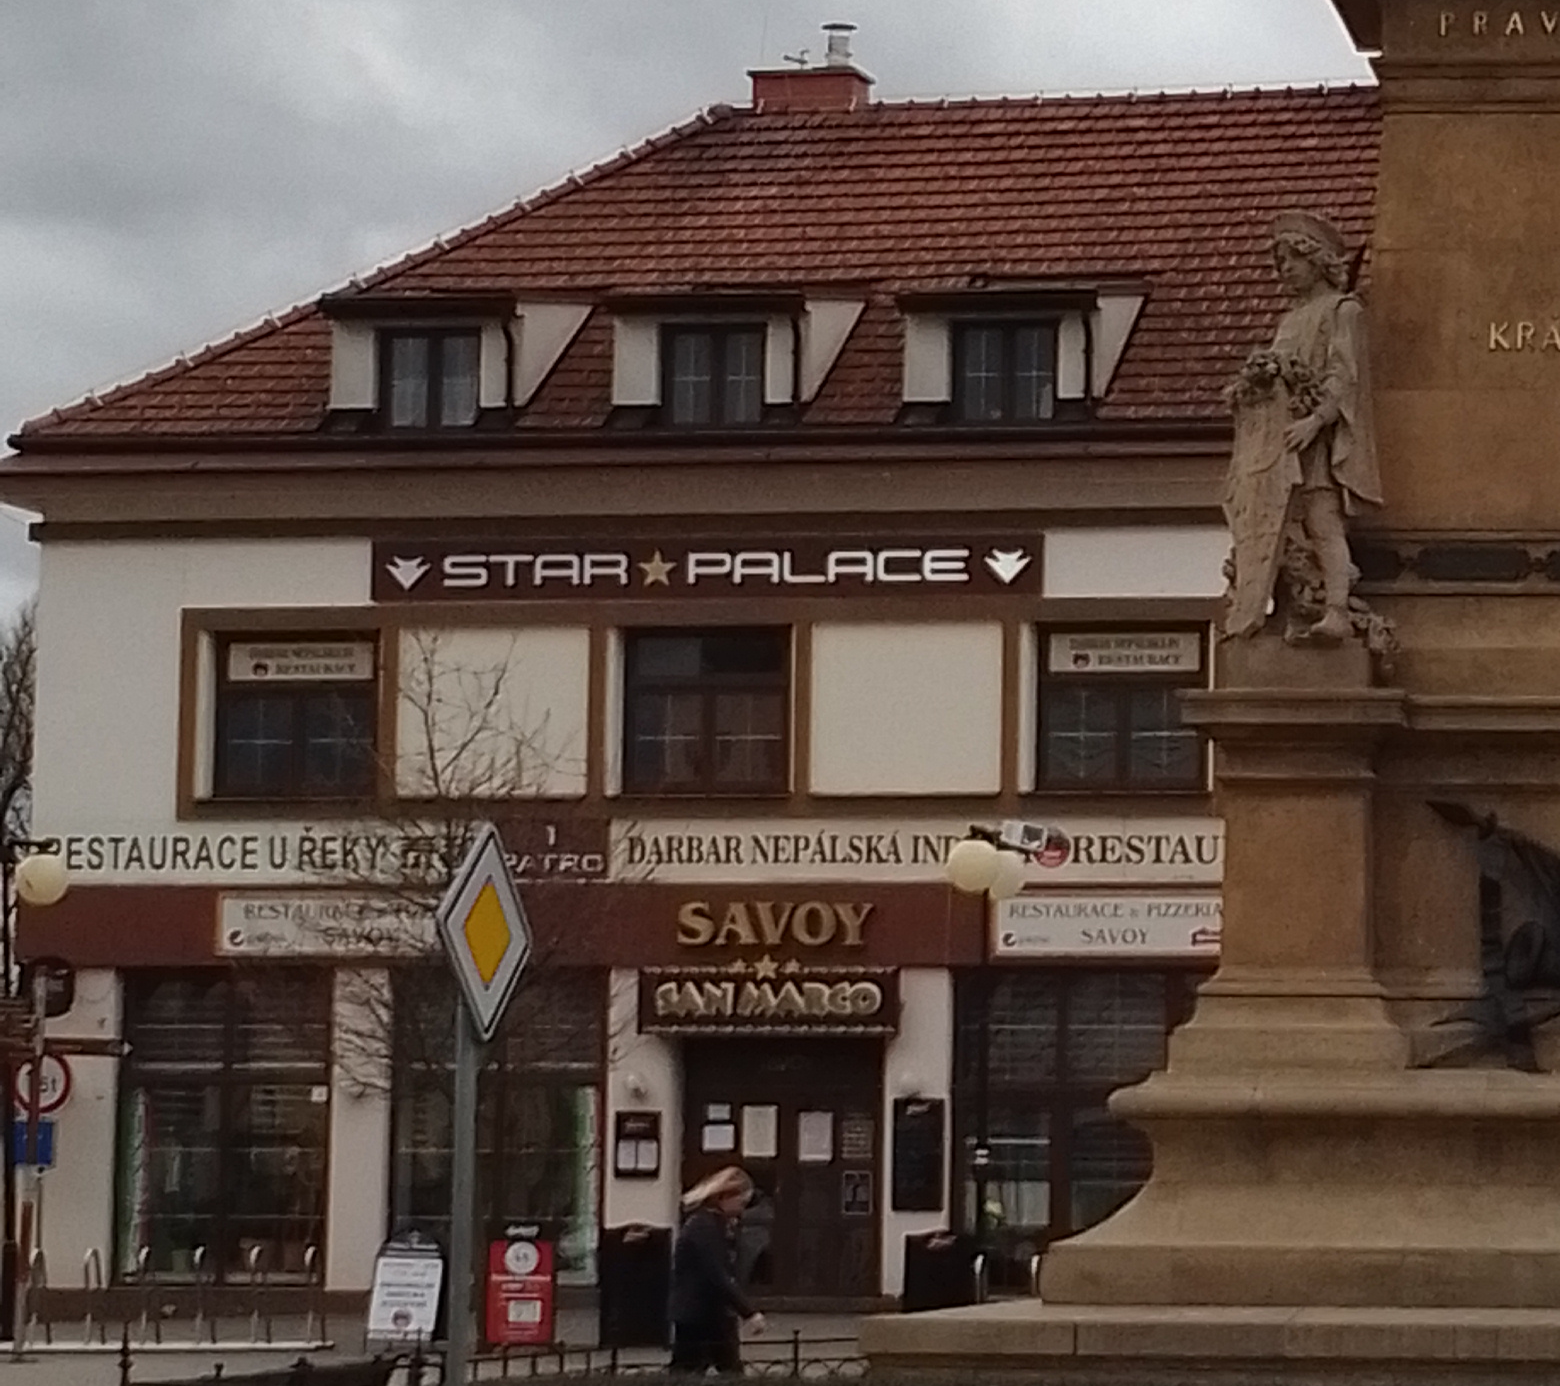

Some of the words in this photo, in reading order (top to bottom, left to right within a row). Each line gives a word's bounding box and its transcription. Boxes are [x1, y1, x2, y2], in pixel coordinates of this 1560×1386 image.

[442, 553, 629, 587] STAR
[687, 548, 970, 585] PALACE
[268, 835, 287, 870] U
[504, 853, 605, 873] PATRO
[626, 834, 745, 865] DARBAR
[751, 828, 903, 865] NEPÁLSKÁ
[676, 900, 875, 947] SAVOY
[1008, 903, 1125, 919] RESTAURACE
[1080, 928, 1150, 945] SAVOY
[655, 980, 736, 1019] SAN
[736, 979, 883, 1019] MARCO
